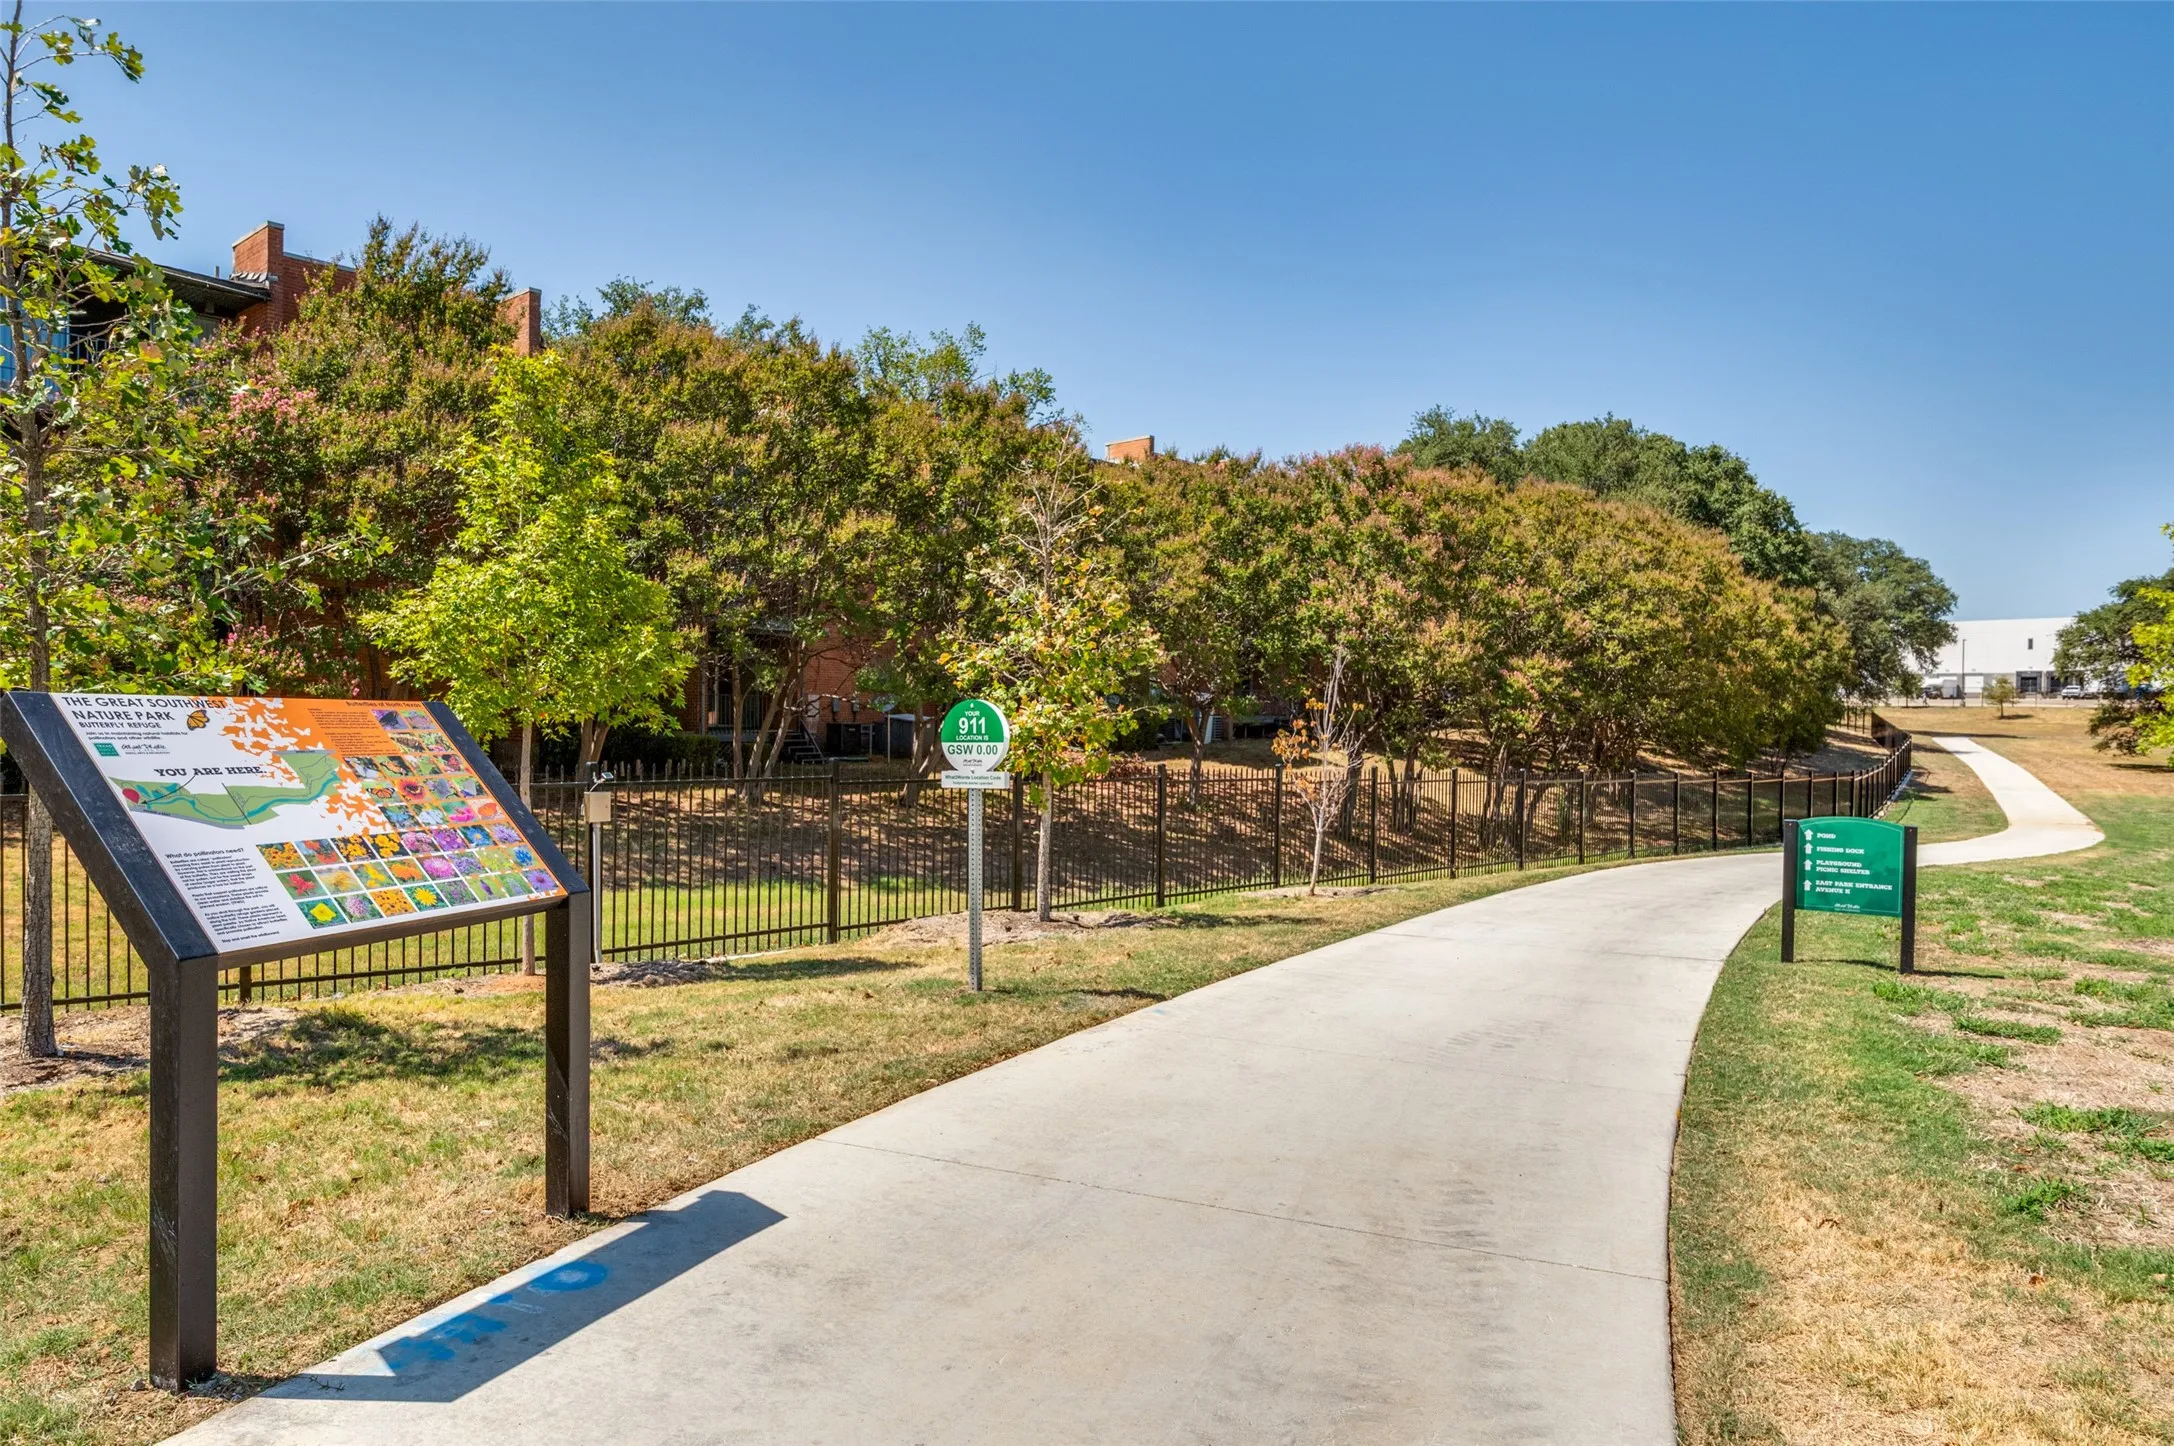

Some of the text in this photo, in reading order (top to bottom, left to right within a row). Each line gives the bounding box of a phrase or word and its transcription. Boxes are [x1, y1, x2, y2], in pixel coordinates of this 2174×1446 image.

[62, 696, 227, 709] THE GREAT SOUTHWEST
[72, 710, 175, 721] NATURE PARK
[958, 717, 986, 734] 911
[948, 745, 998, 755] GSW 0.00
[154, 766, 267, 777] YOU ARE HERE.
